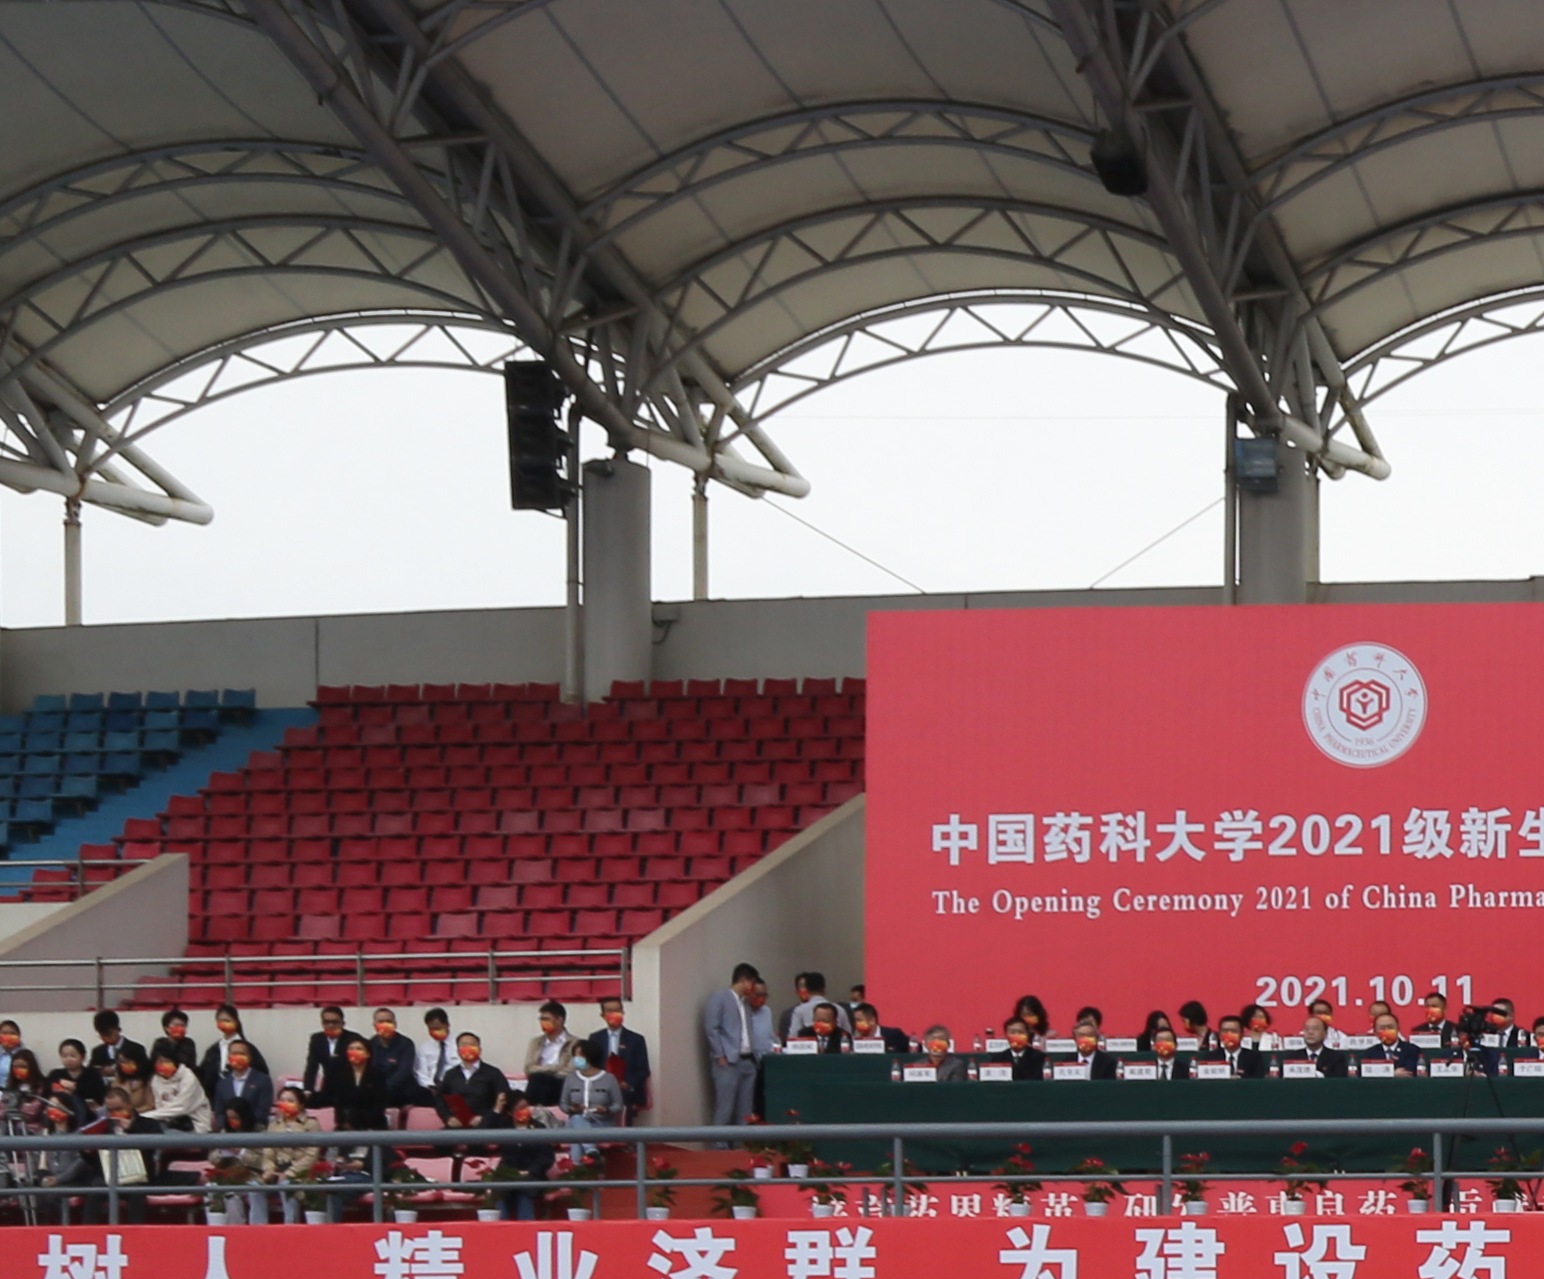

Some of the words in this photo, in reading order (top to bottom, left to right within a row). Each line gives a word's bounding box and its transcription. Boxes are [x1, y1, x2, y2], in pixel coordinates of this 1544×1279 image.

[932, 890, 980, 914] The
[992, 888, 1101, 920] Opening
[1113, 887, 1244, 917] Ceremony
[1256, 886, 1311, 910] 2021
[1325, 884, 1354, 909] of
[1362, 884, 1437, 909] China
[1255, 975, 1472, 1006] 2021.10.11
